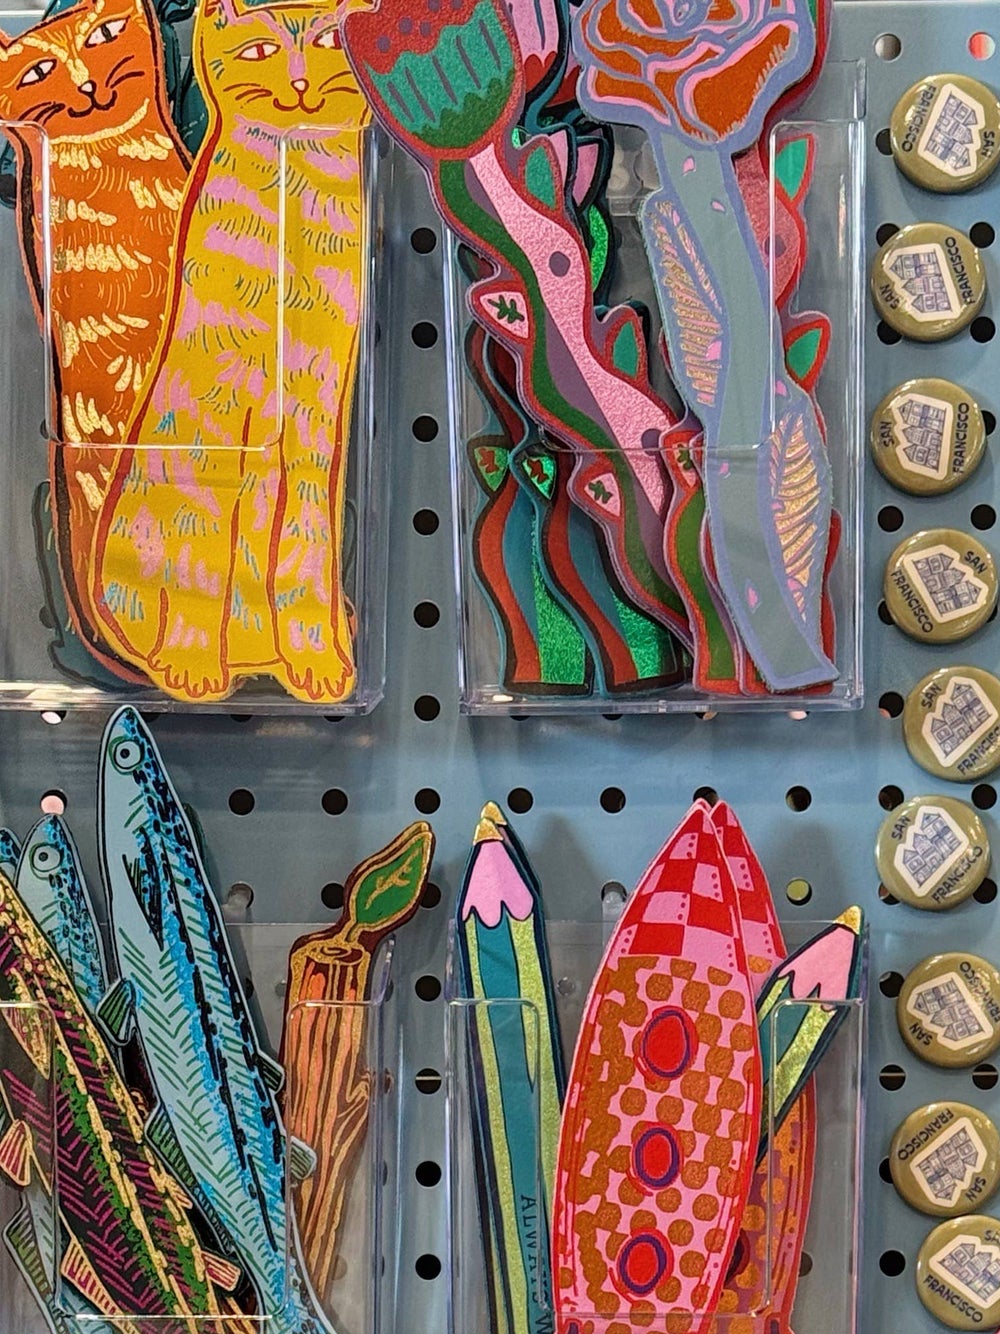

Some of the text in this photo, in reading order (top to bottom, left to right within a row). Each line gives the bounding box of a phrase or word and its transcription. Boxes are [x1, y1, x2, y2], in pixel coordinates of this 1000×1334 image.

[881, 421, 894, 447] SAN
[953, 402, 969, 473] FRANCISCO
[922, 1274, 984, 1324] FRANCISCO
